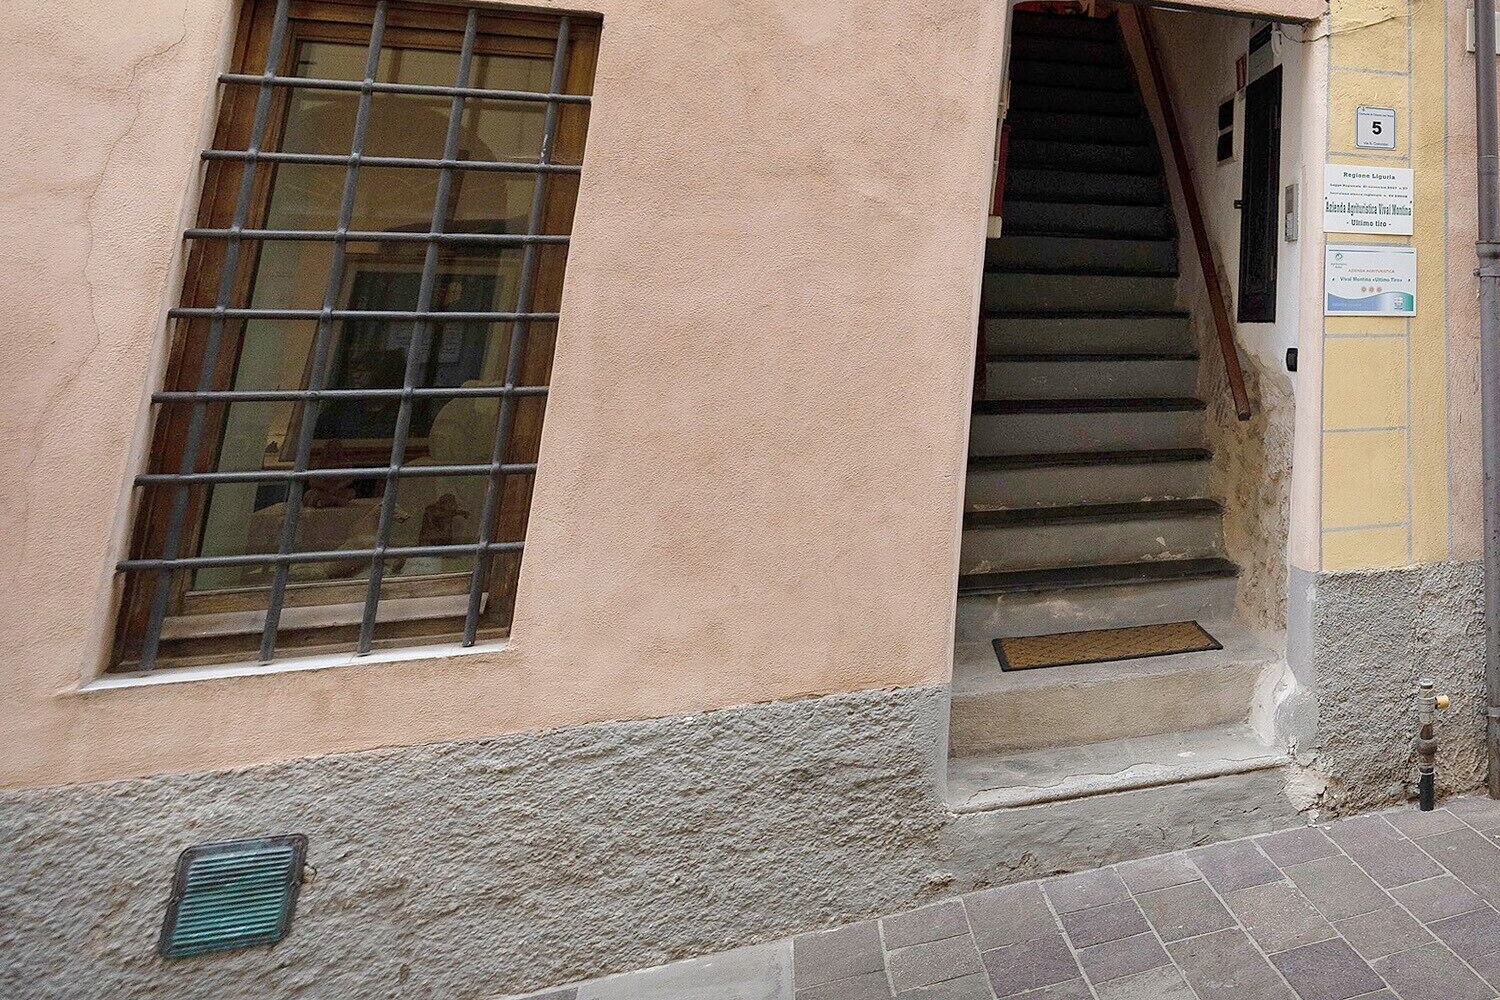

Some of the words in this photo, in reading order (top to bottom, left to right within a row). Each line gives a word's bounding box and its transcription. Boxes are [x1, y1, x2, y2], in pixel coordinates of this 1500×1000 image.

[1371, 121, 1383, 135] 5
[1325, 201, 1346, 213] Azienda
[1347, 202, 1377, 216] Agrituristica
[1351, 219, 1374, 227] Ultimo
